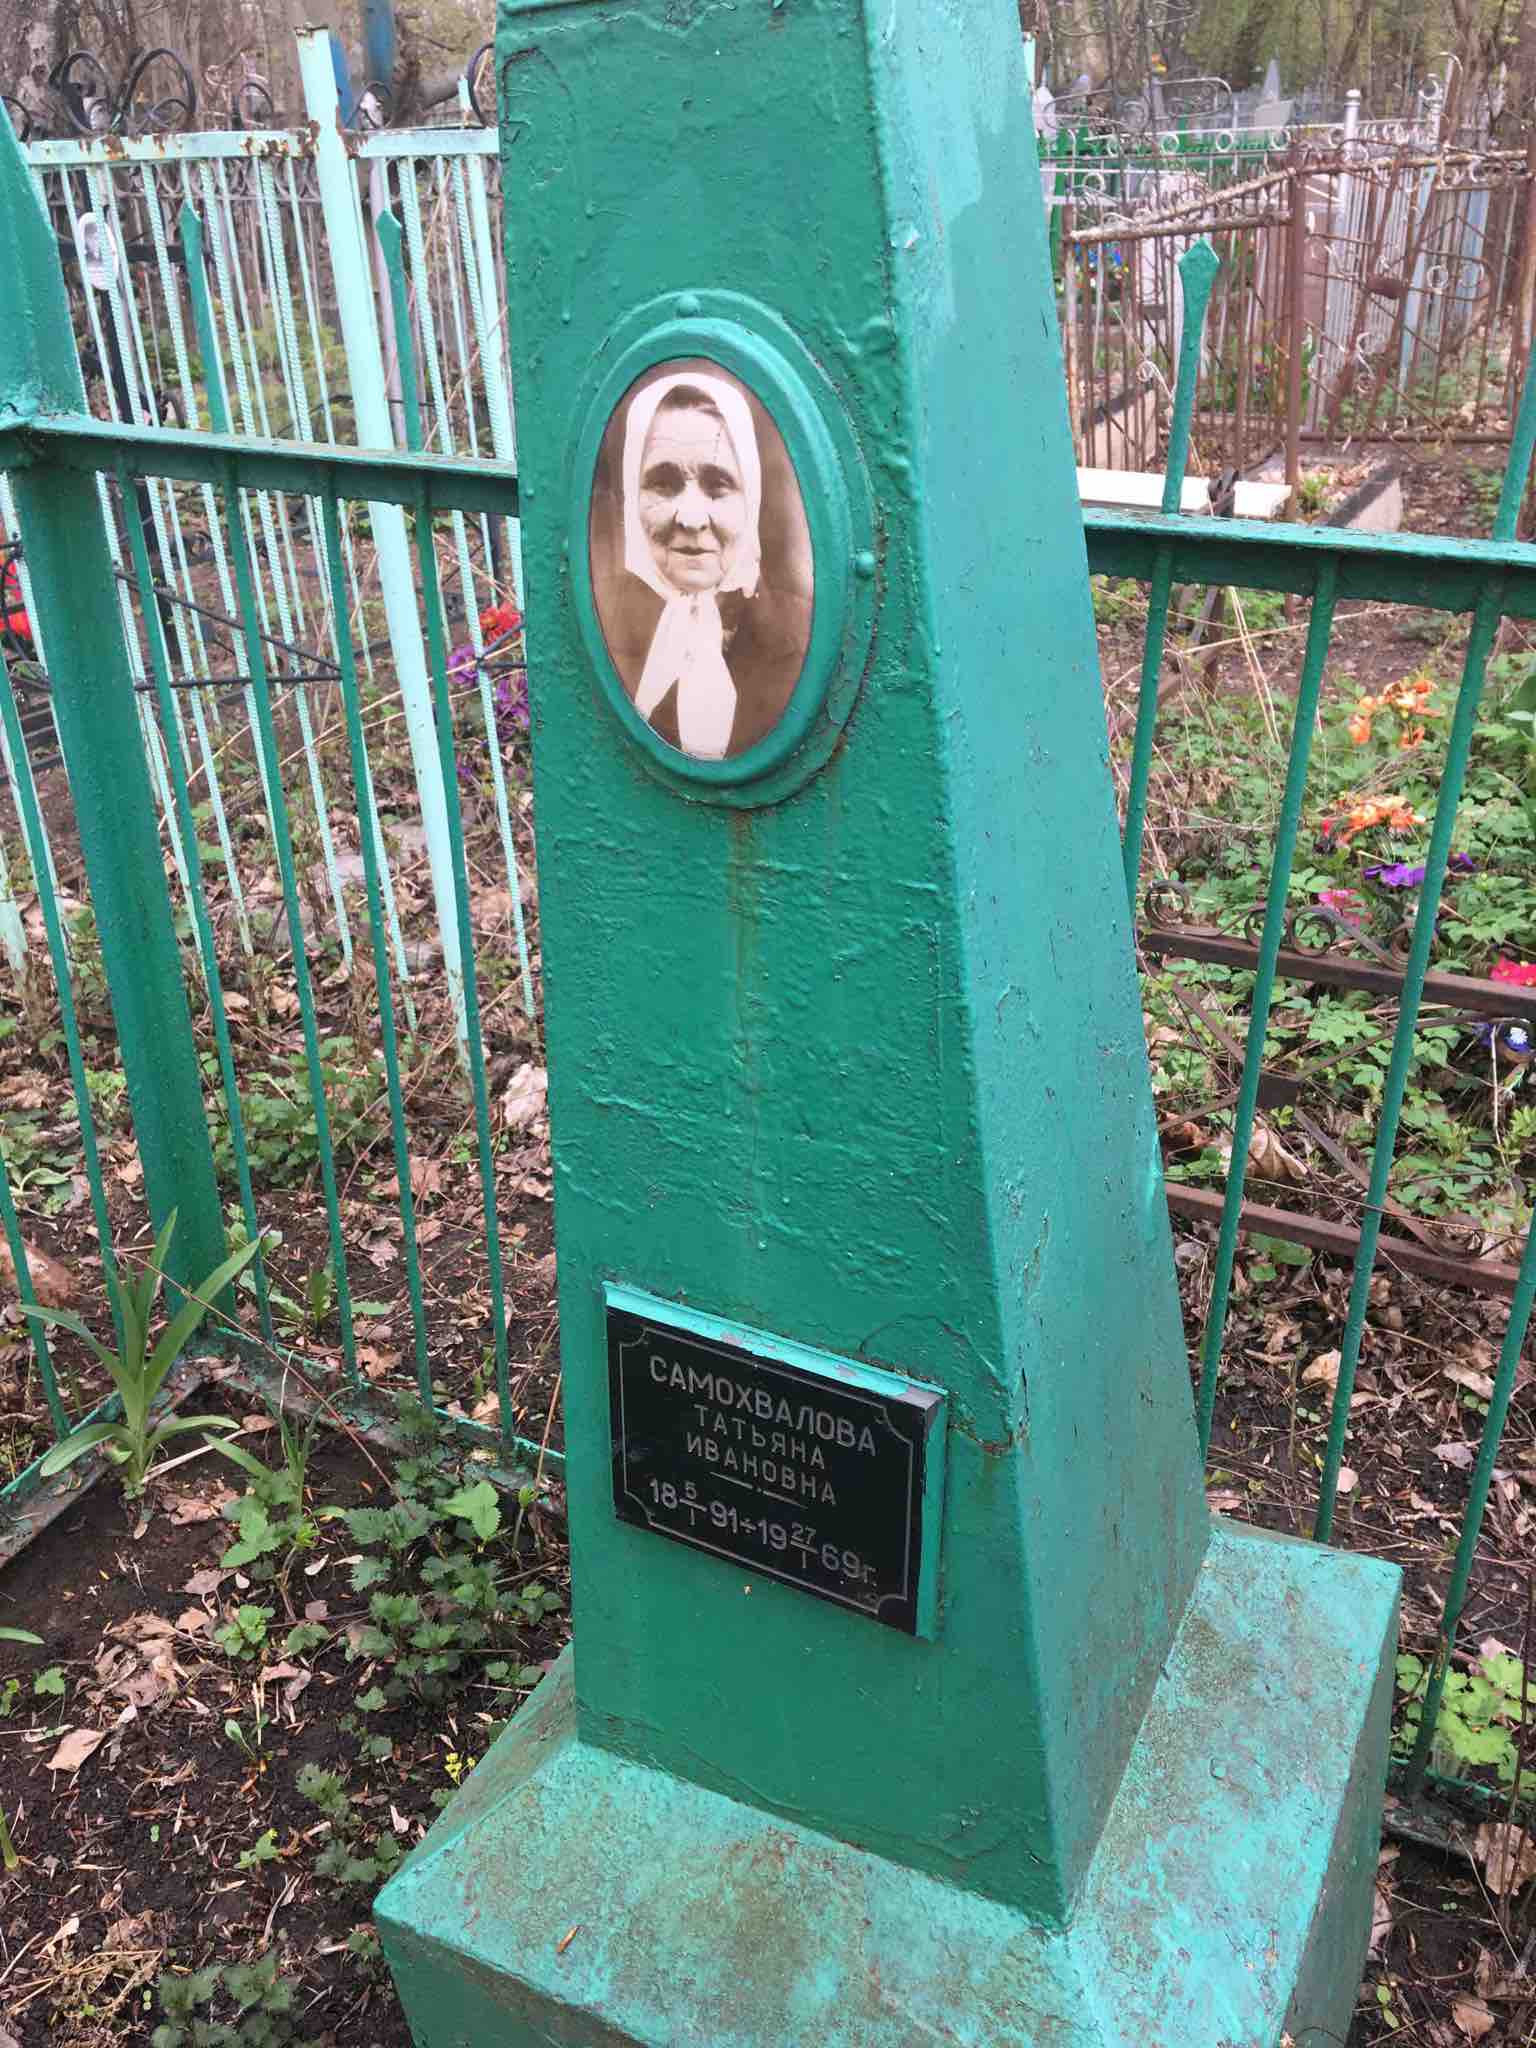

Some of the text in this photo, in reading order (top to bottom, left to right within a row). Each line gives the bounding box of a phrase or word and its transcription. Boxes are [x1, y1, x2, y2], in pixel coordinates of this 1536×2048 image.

[650, 1355, 877, 1457] САМОХВАЛОВА
[693, 1403, 826, 1470] ТАТЬЯНА
[687, 1432, 837, 1506] ИВАНОВНА
